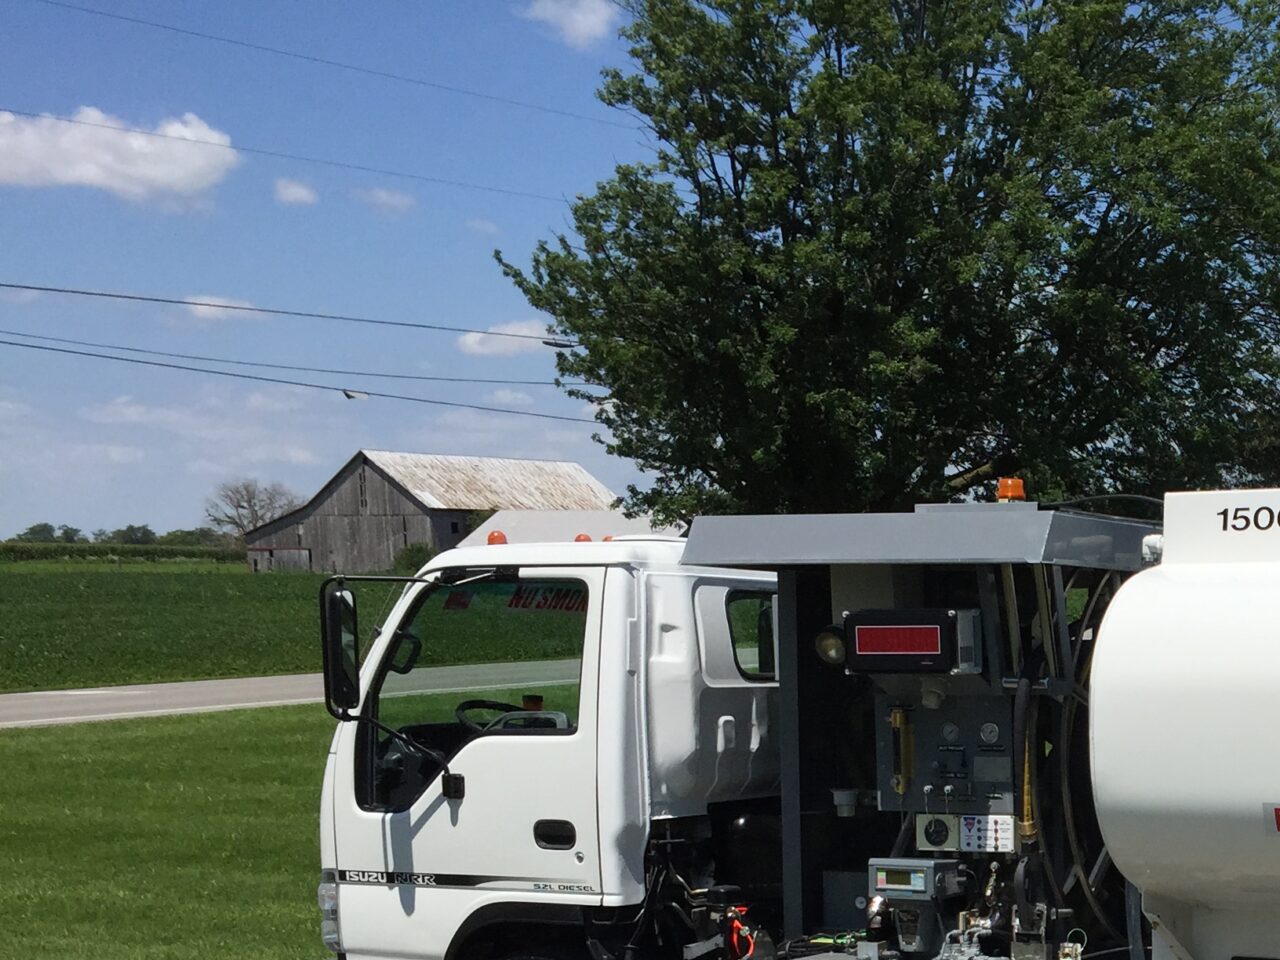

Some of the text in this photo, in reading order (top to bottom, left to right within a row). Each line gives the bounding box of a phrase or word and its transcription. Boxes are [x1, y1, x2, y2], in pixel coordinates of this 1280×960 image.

[508, 585, 539, 608] NO
[345, 870, 437, 886] ISUZU NRR
[558, 884, 596, 892] DIESEL
